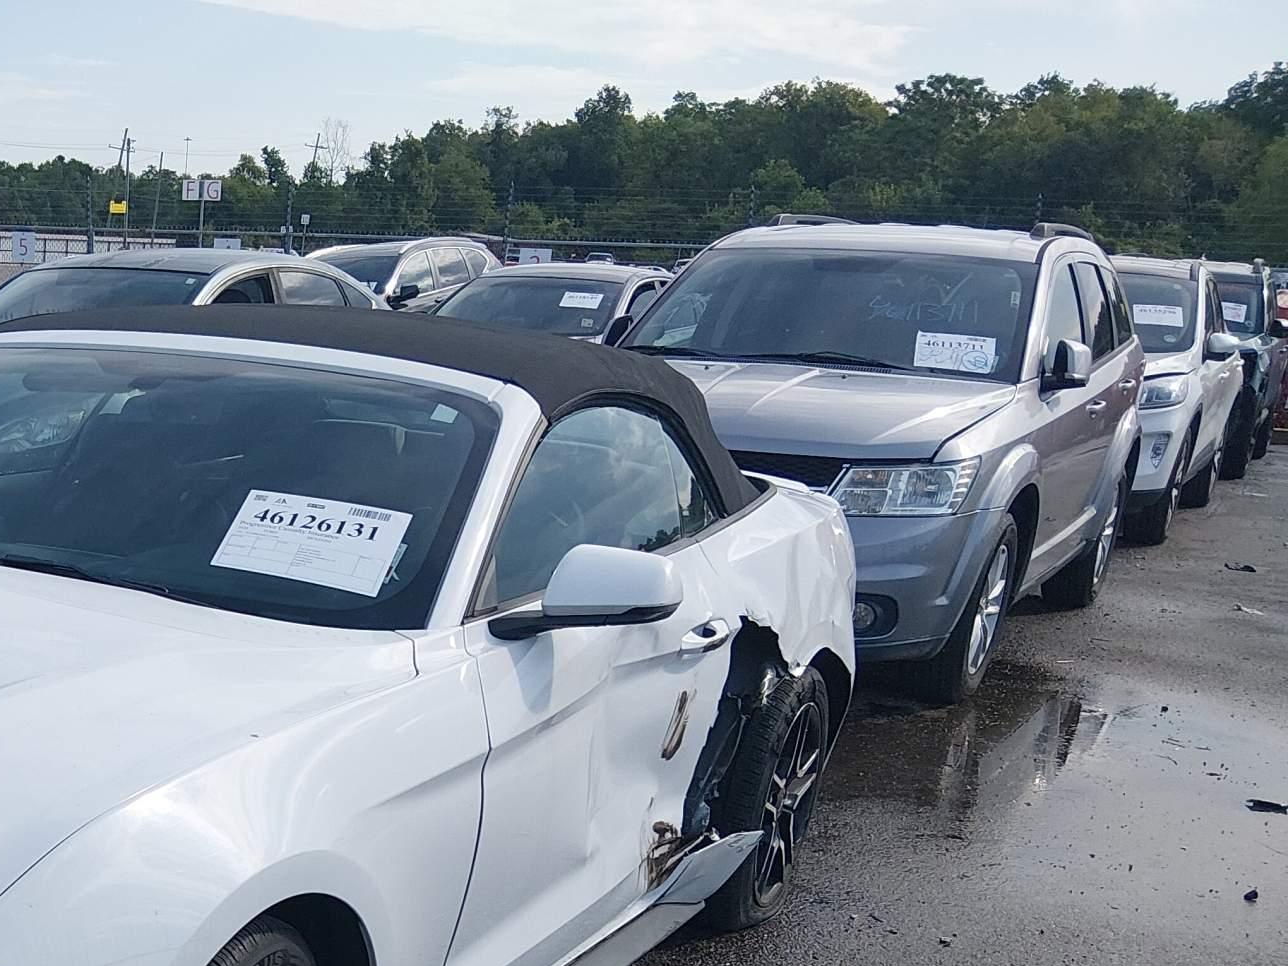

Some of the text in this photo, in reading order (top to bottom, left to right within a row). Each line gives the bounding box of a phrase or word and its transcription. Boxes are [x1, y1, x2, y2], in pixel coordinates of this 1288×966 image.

[186, 181, 219, 200] F G
[19, 238, 28, 256] 5
[924, 339, 984, 350] 46113711
[253, 508, 380, 542] 46126131
